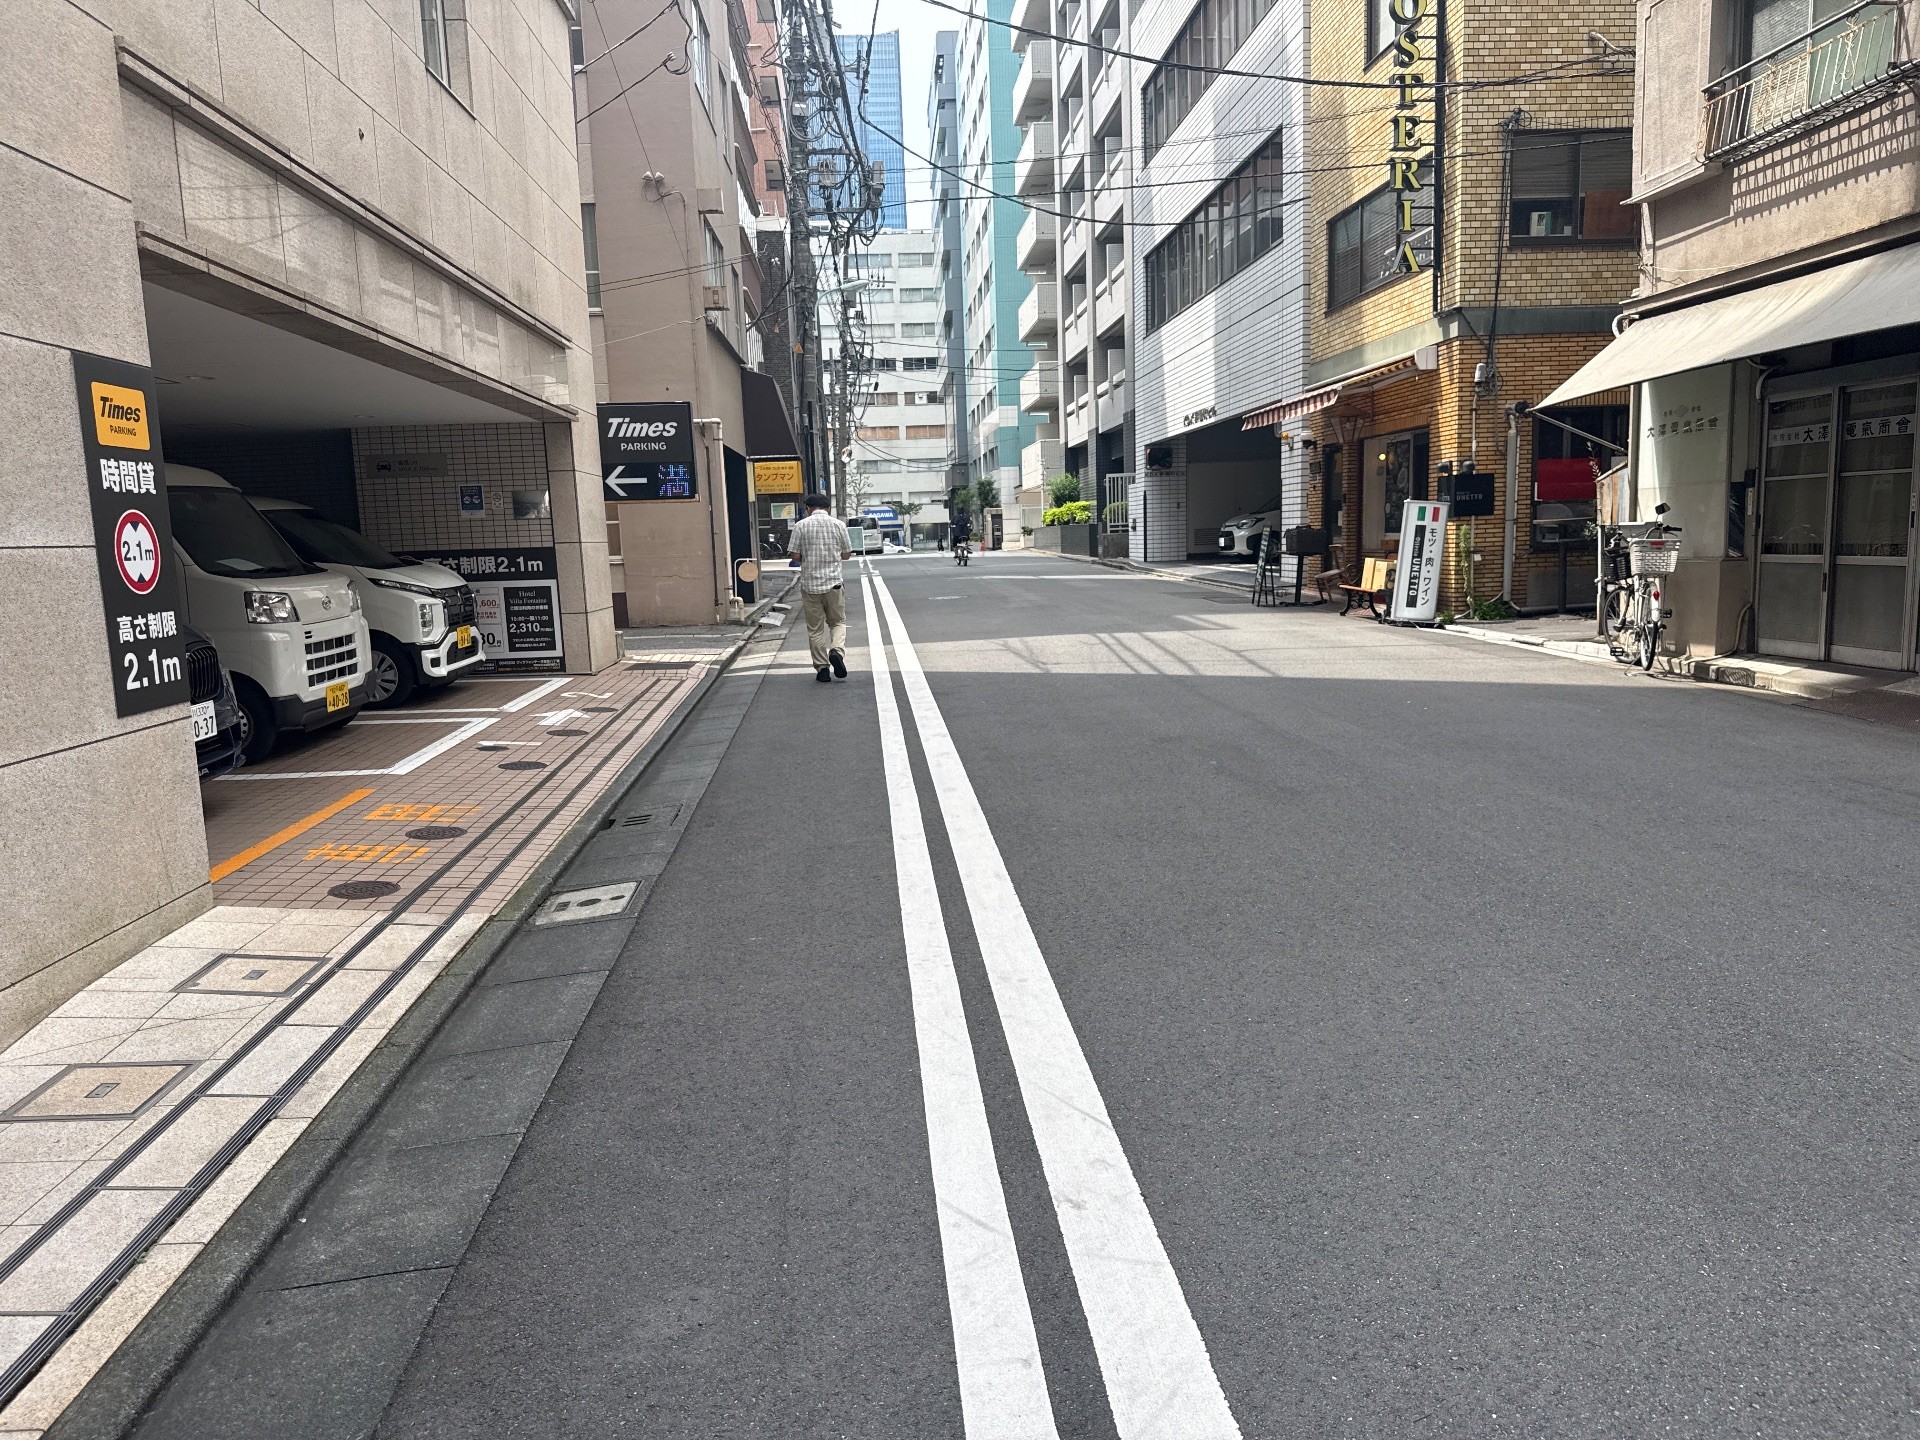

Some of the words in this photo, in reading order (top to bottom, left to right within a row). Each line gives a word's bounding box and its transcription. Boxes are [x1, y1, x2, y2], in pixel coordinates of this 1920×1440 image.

[1389, 0, 1428, 275] OSTERIA
[99, 395, 142, 424] Times
[109, 424, 137, 438] PARKING
[607, 417, 678, 438] Times
[620, 441, 667, 451] PARKING
[100, 458, 157, 495] 時間貸
[121, 539, 155, 562] 2.1m
[1408, 557, 1422, 596] UNETTO
[117, 611, 178, 644] 高さ制限
[509, 622, 540, 634] 2,310
[123, 648, 182, 691] 2.1m
[193, 715, 214, 738] 0-37
